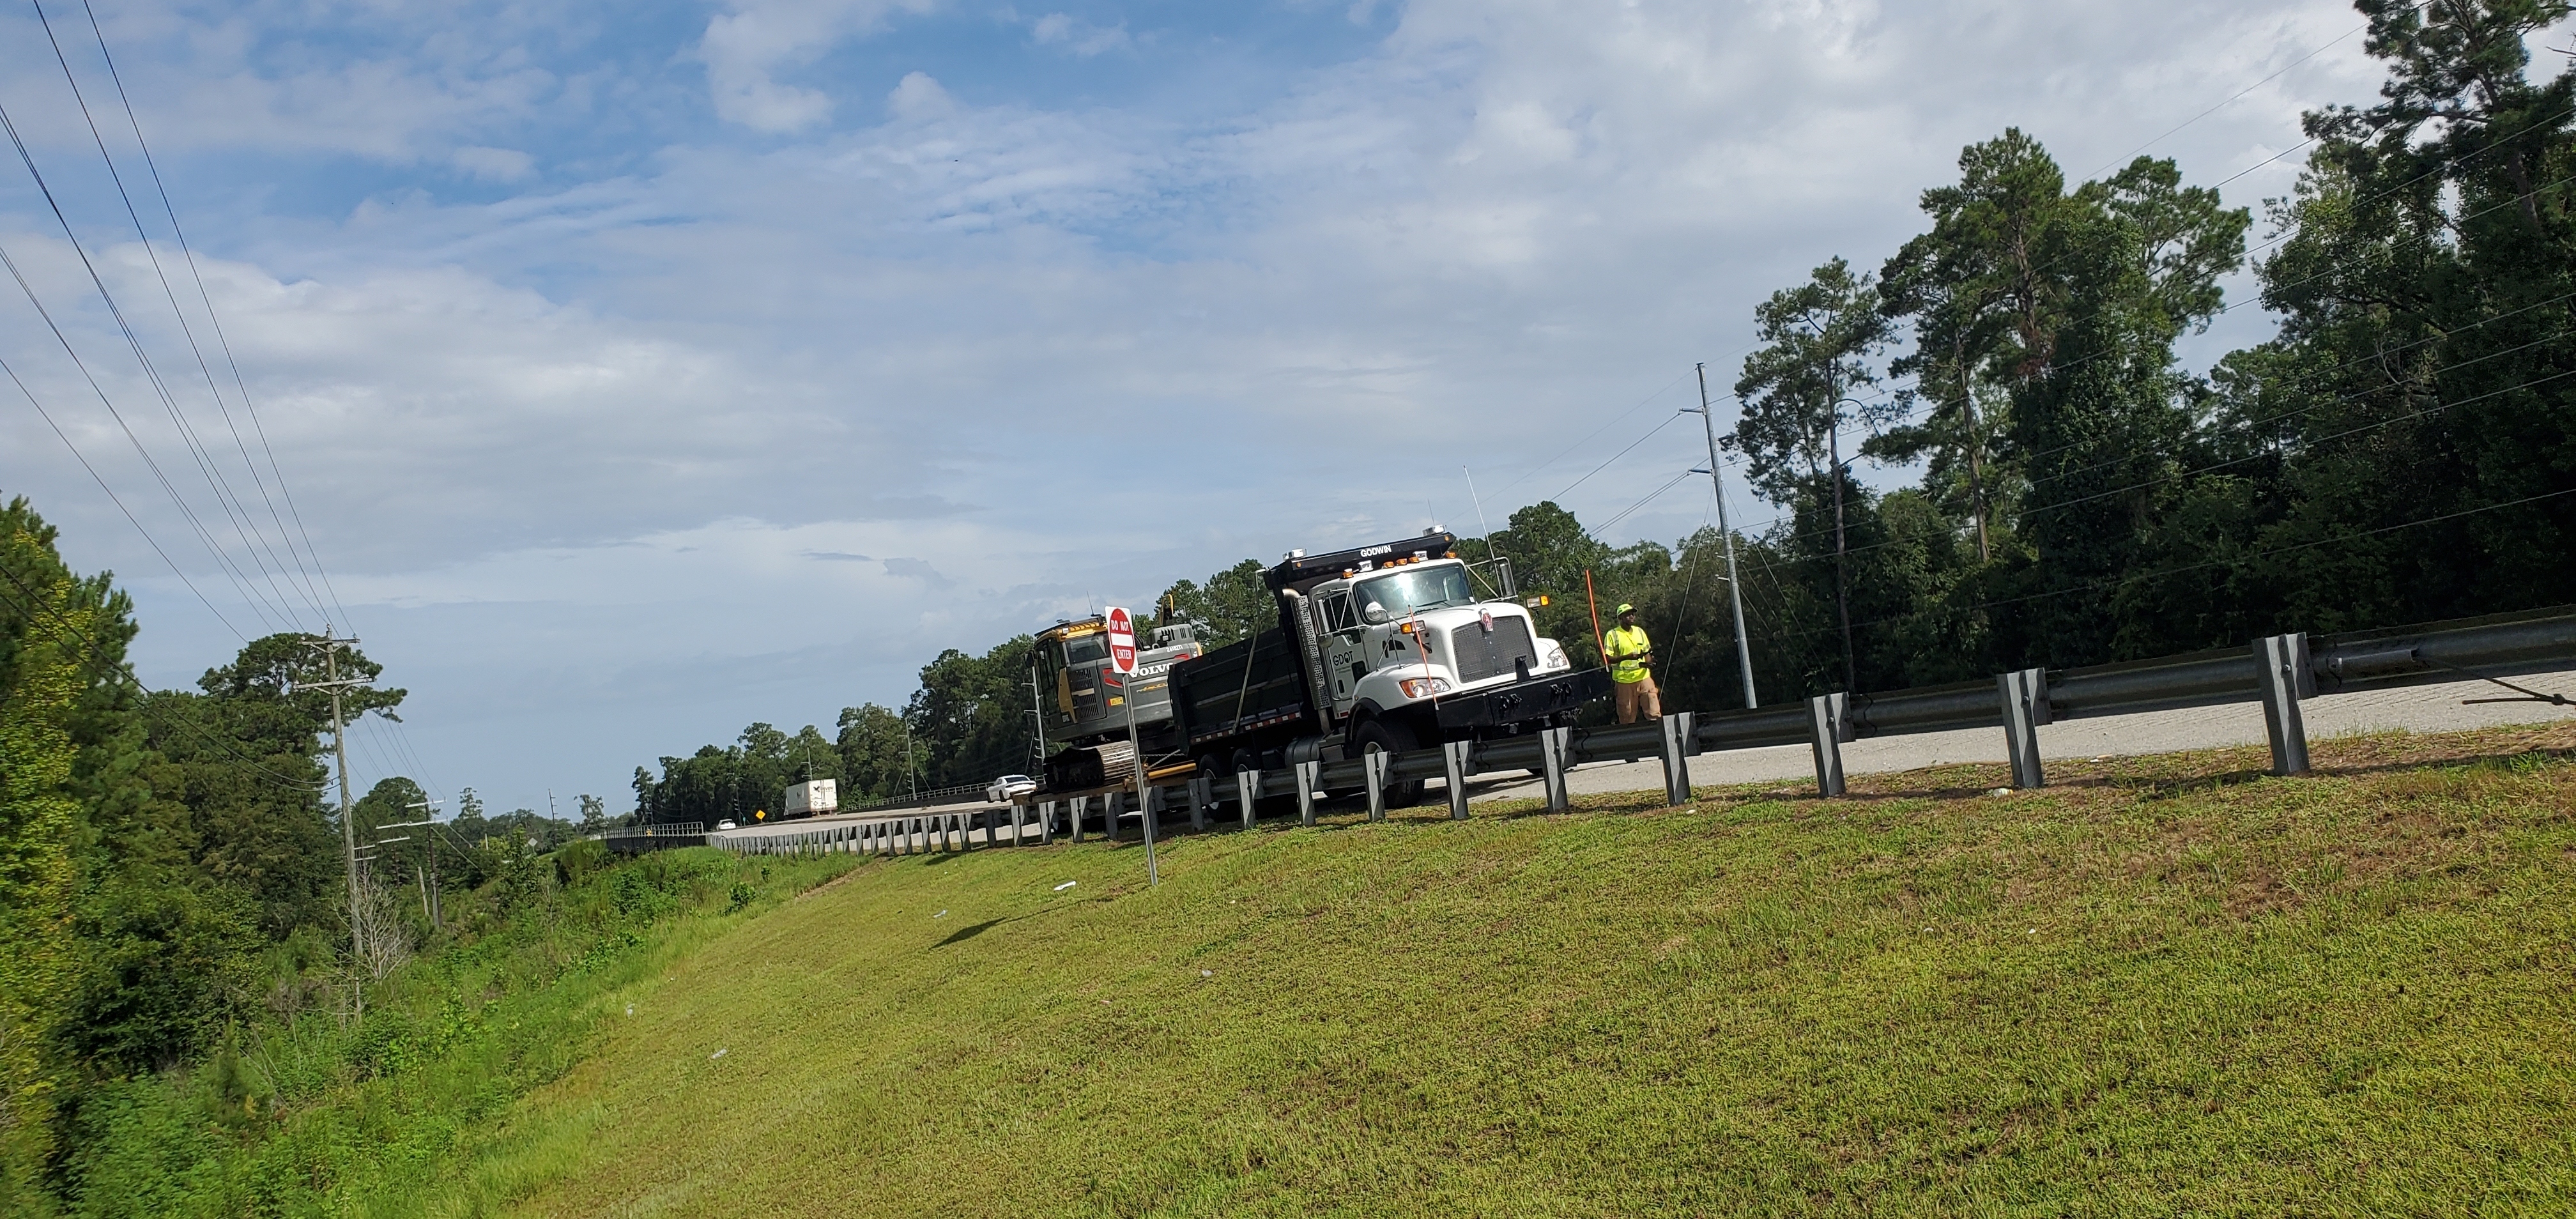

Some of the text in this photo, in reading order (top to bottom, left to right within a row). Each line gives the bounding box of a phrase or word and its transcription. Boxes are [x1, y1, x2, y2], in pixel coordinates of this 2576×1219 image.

[1360, 545, 1392, 557] GODWIN
[1111, 620, 1129, 632] DO NOT
[1117, 648, 1132, 660] ENTER
[1333, 650, 1353, 666] GDOT
